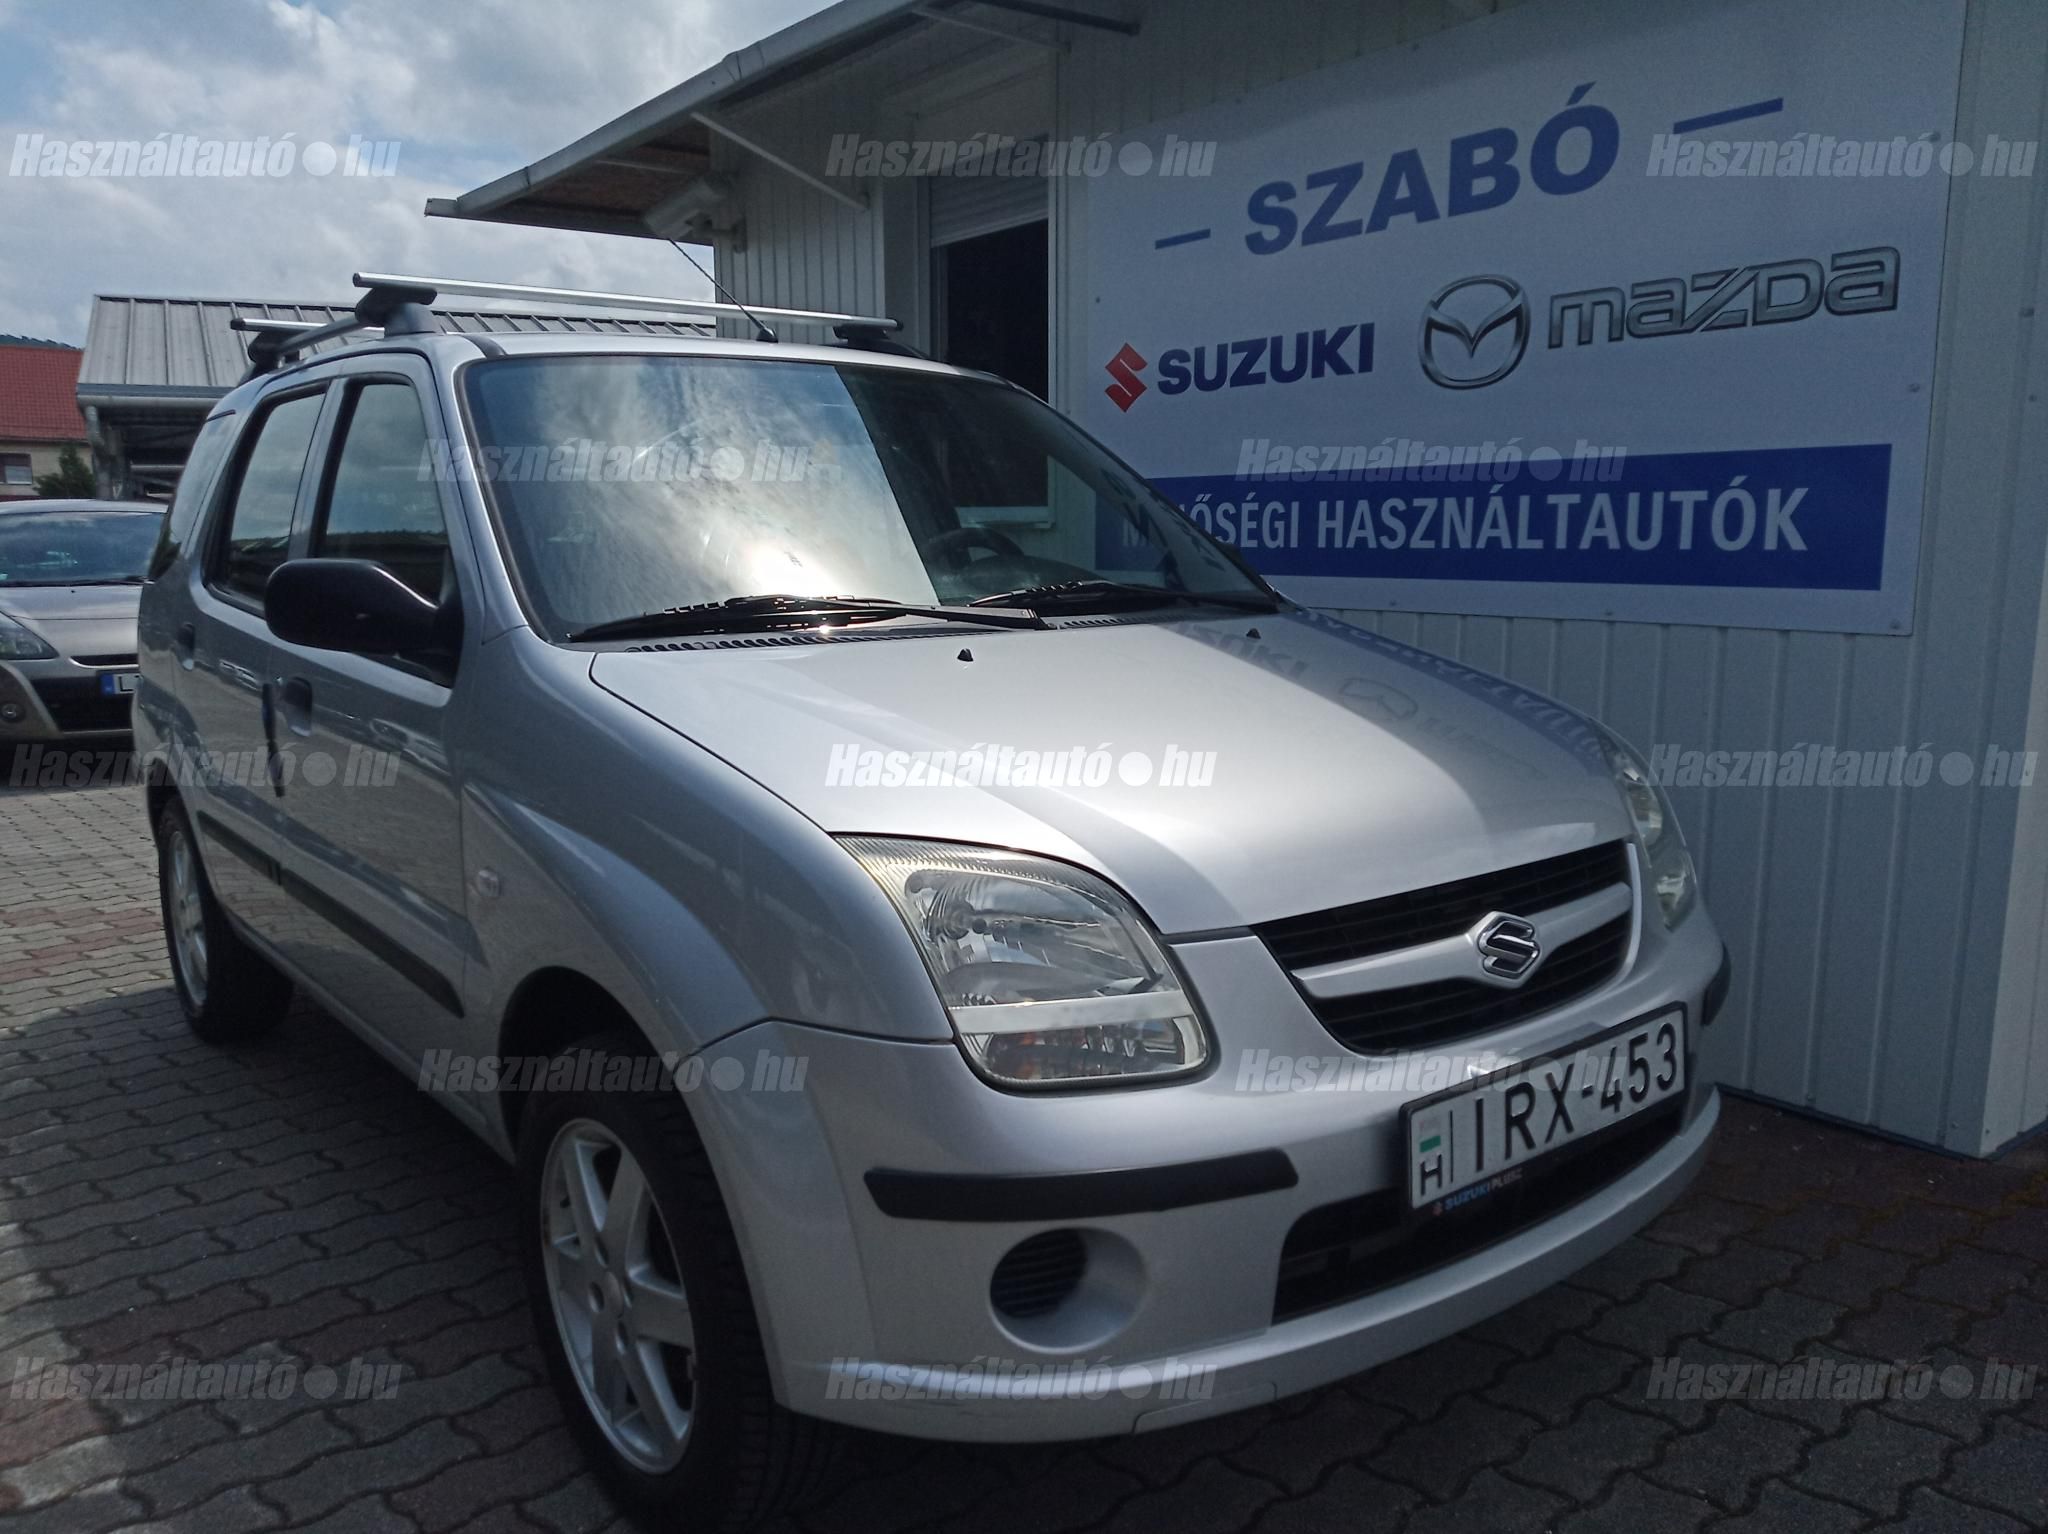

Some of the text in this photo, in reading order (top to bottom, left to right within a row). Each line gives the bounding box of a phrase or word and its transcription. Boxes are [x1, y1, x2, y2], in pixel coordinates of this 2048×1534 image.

[1245, 82, 1621, 256] SZABÓ
[1157, 322, 1375, 395] SUZUKI
[1317, 474, 1809, 552] HASZNÁLTAUTÓK
[1475, 1022, 1677, 1172] IRX-453
